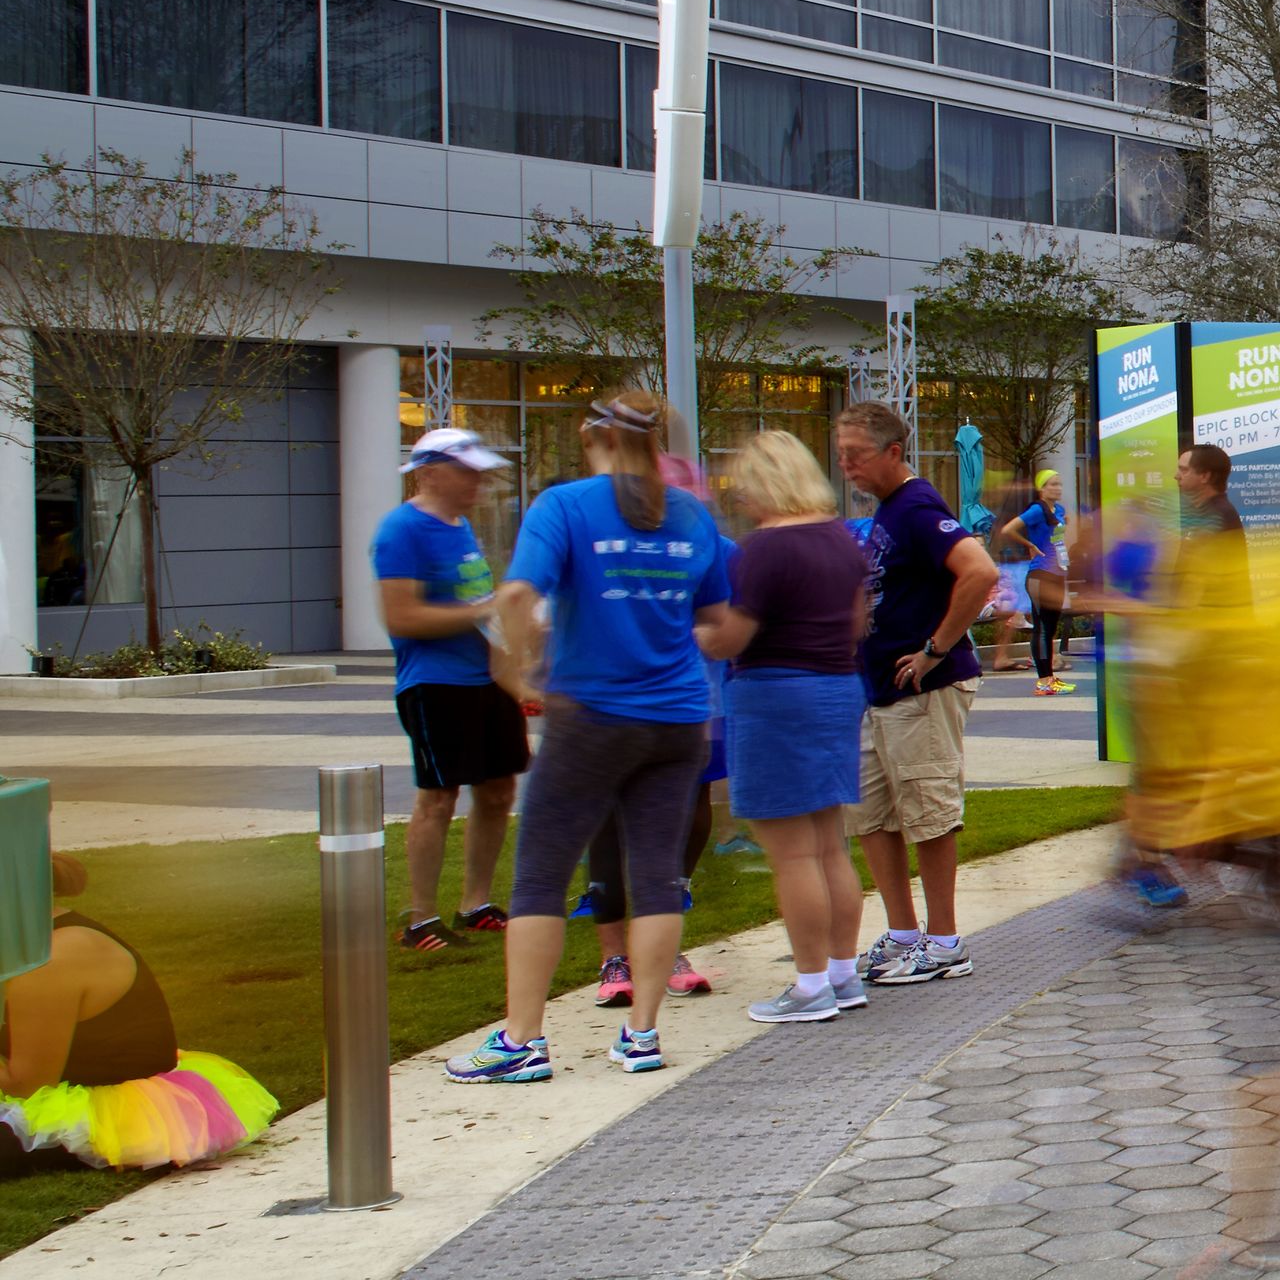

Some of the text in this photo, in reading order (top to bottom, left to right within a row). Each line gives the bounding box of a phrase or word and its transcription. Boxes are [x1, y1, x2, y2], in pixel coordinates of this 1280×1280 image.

[1123, 345, 1152, 372] RUN
[1118, 365, 1159, 395] NONA
[1198, 419, 1228, 436] EPIC
[1234, 409, 1278, 428] BLOCK
[1239, 431, 1258, 445] PM
